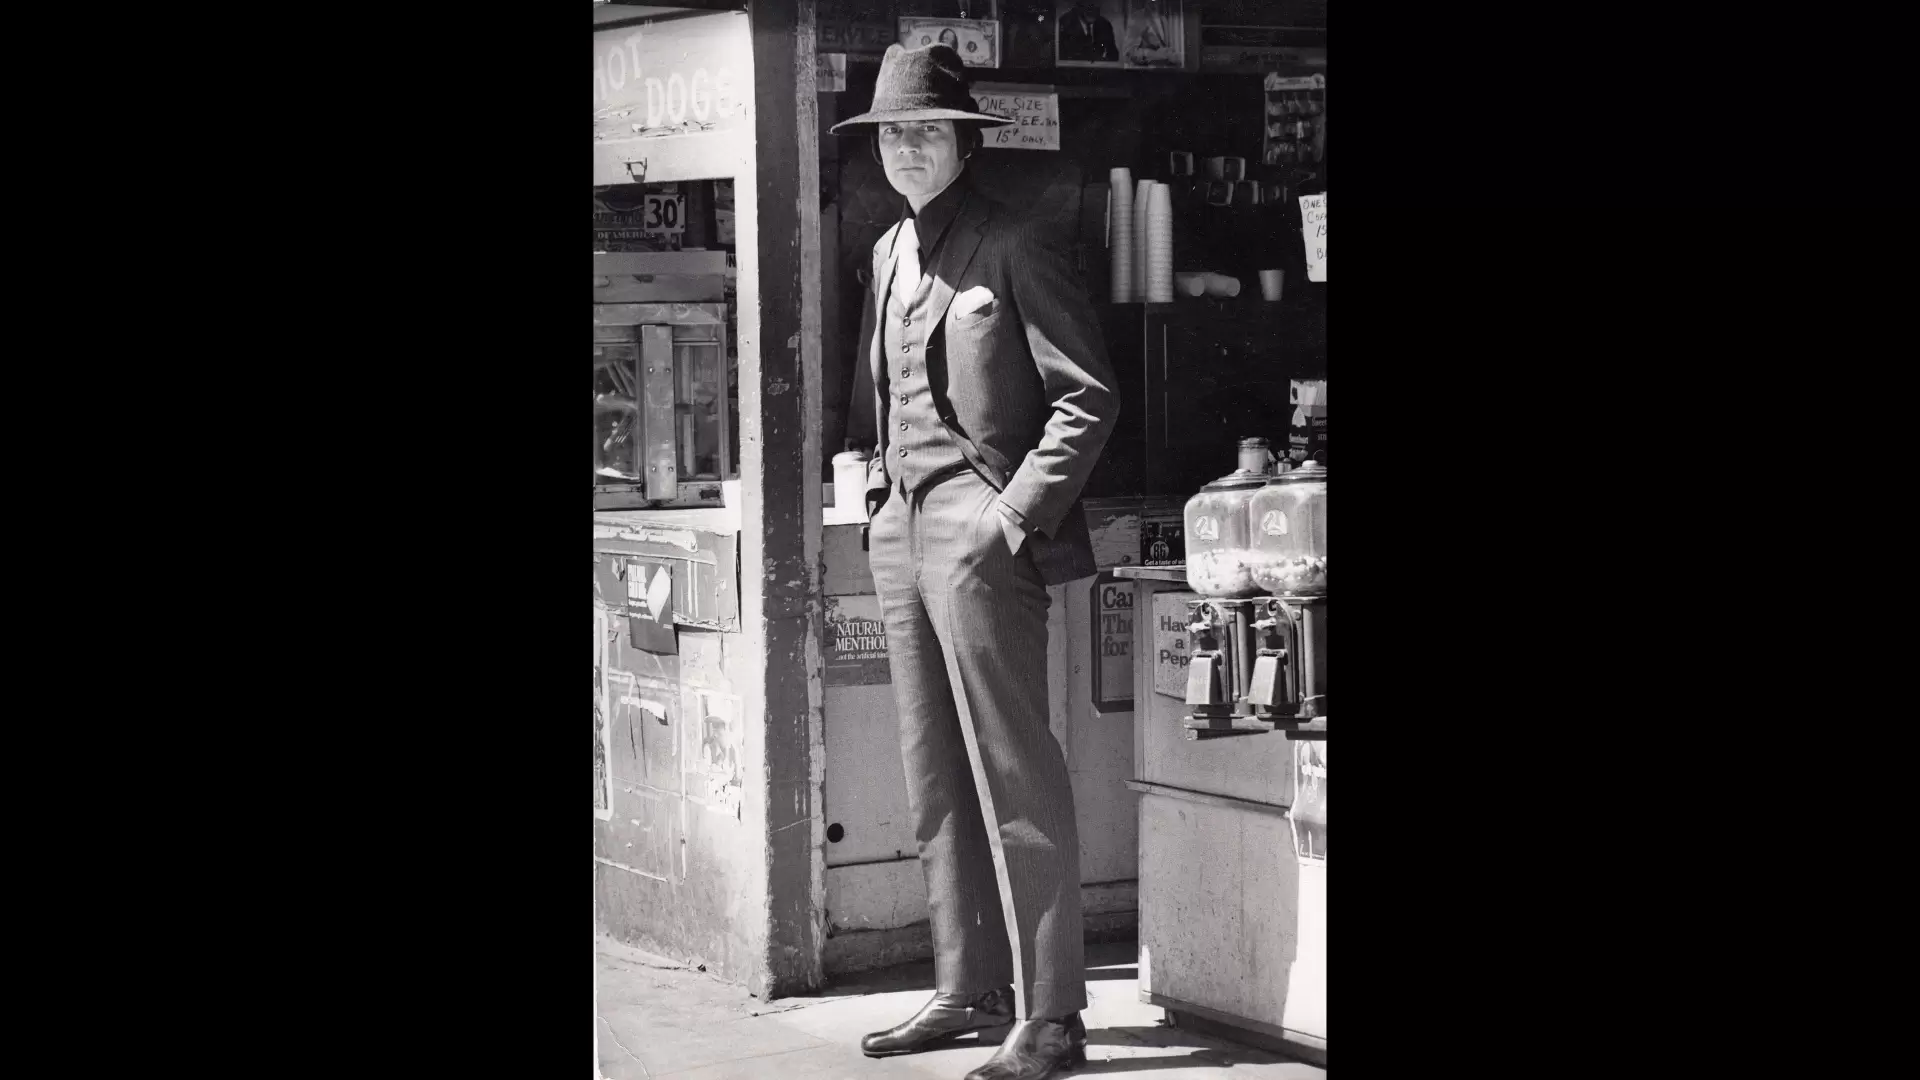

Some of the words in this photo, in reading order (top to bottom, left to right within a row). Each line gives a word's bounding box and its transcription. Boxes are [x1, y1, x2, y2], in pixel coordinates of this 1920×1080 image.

[645, 67, 735, 127] DOGS
[978, 96, 1005, 112] ONE
[1014, 97, 1043, 111] SIZE
[1303, 199, 1321, 210] ONE
[837, 621, 885, 636] NATURAL
[1161, 616, 1189, 632] Hav
[835, 636, 888, 651] MENTHOL
[1103, 636, 1128, 656] for
[1175, 639, 1184, 649] a
[1160, 650, 1191, 668] Pep
